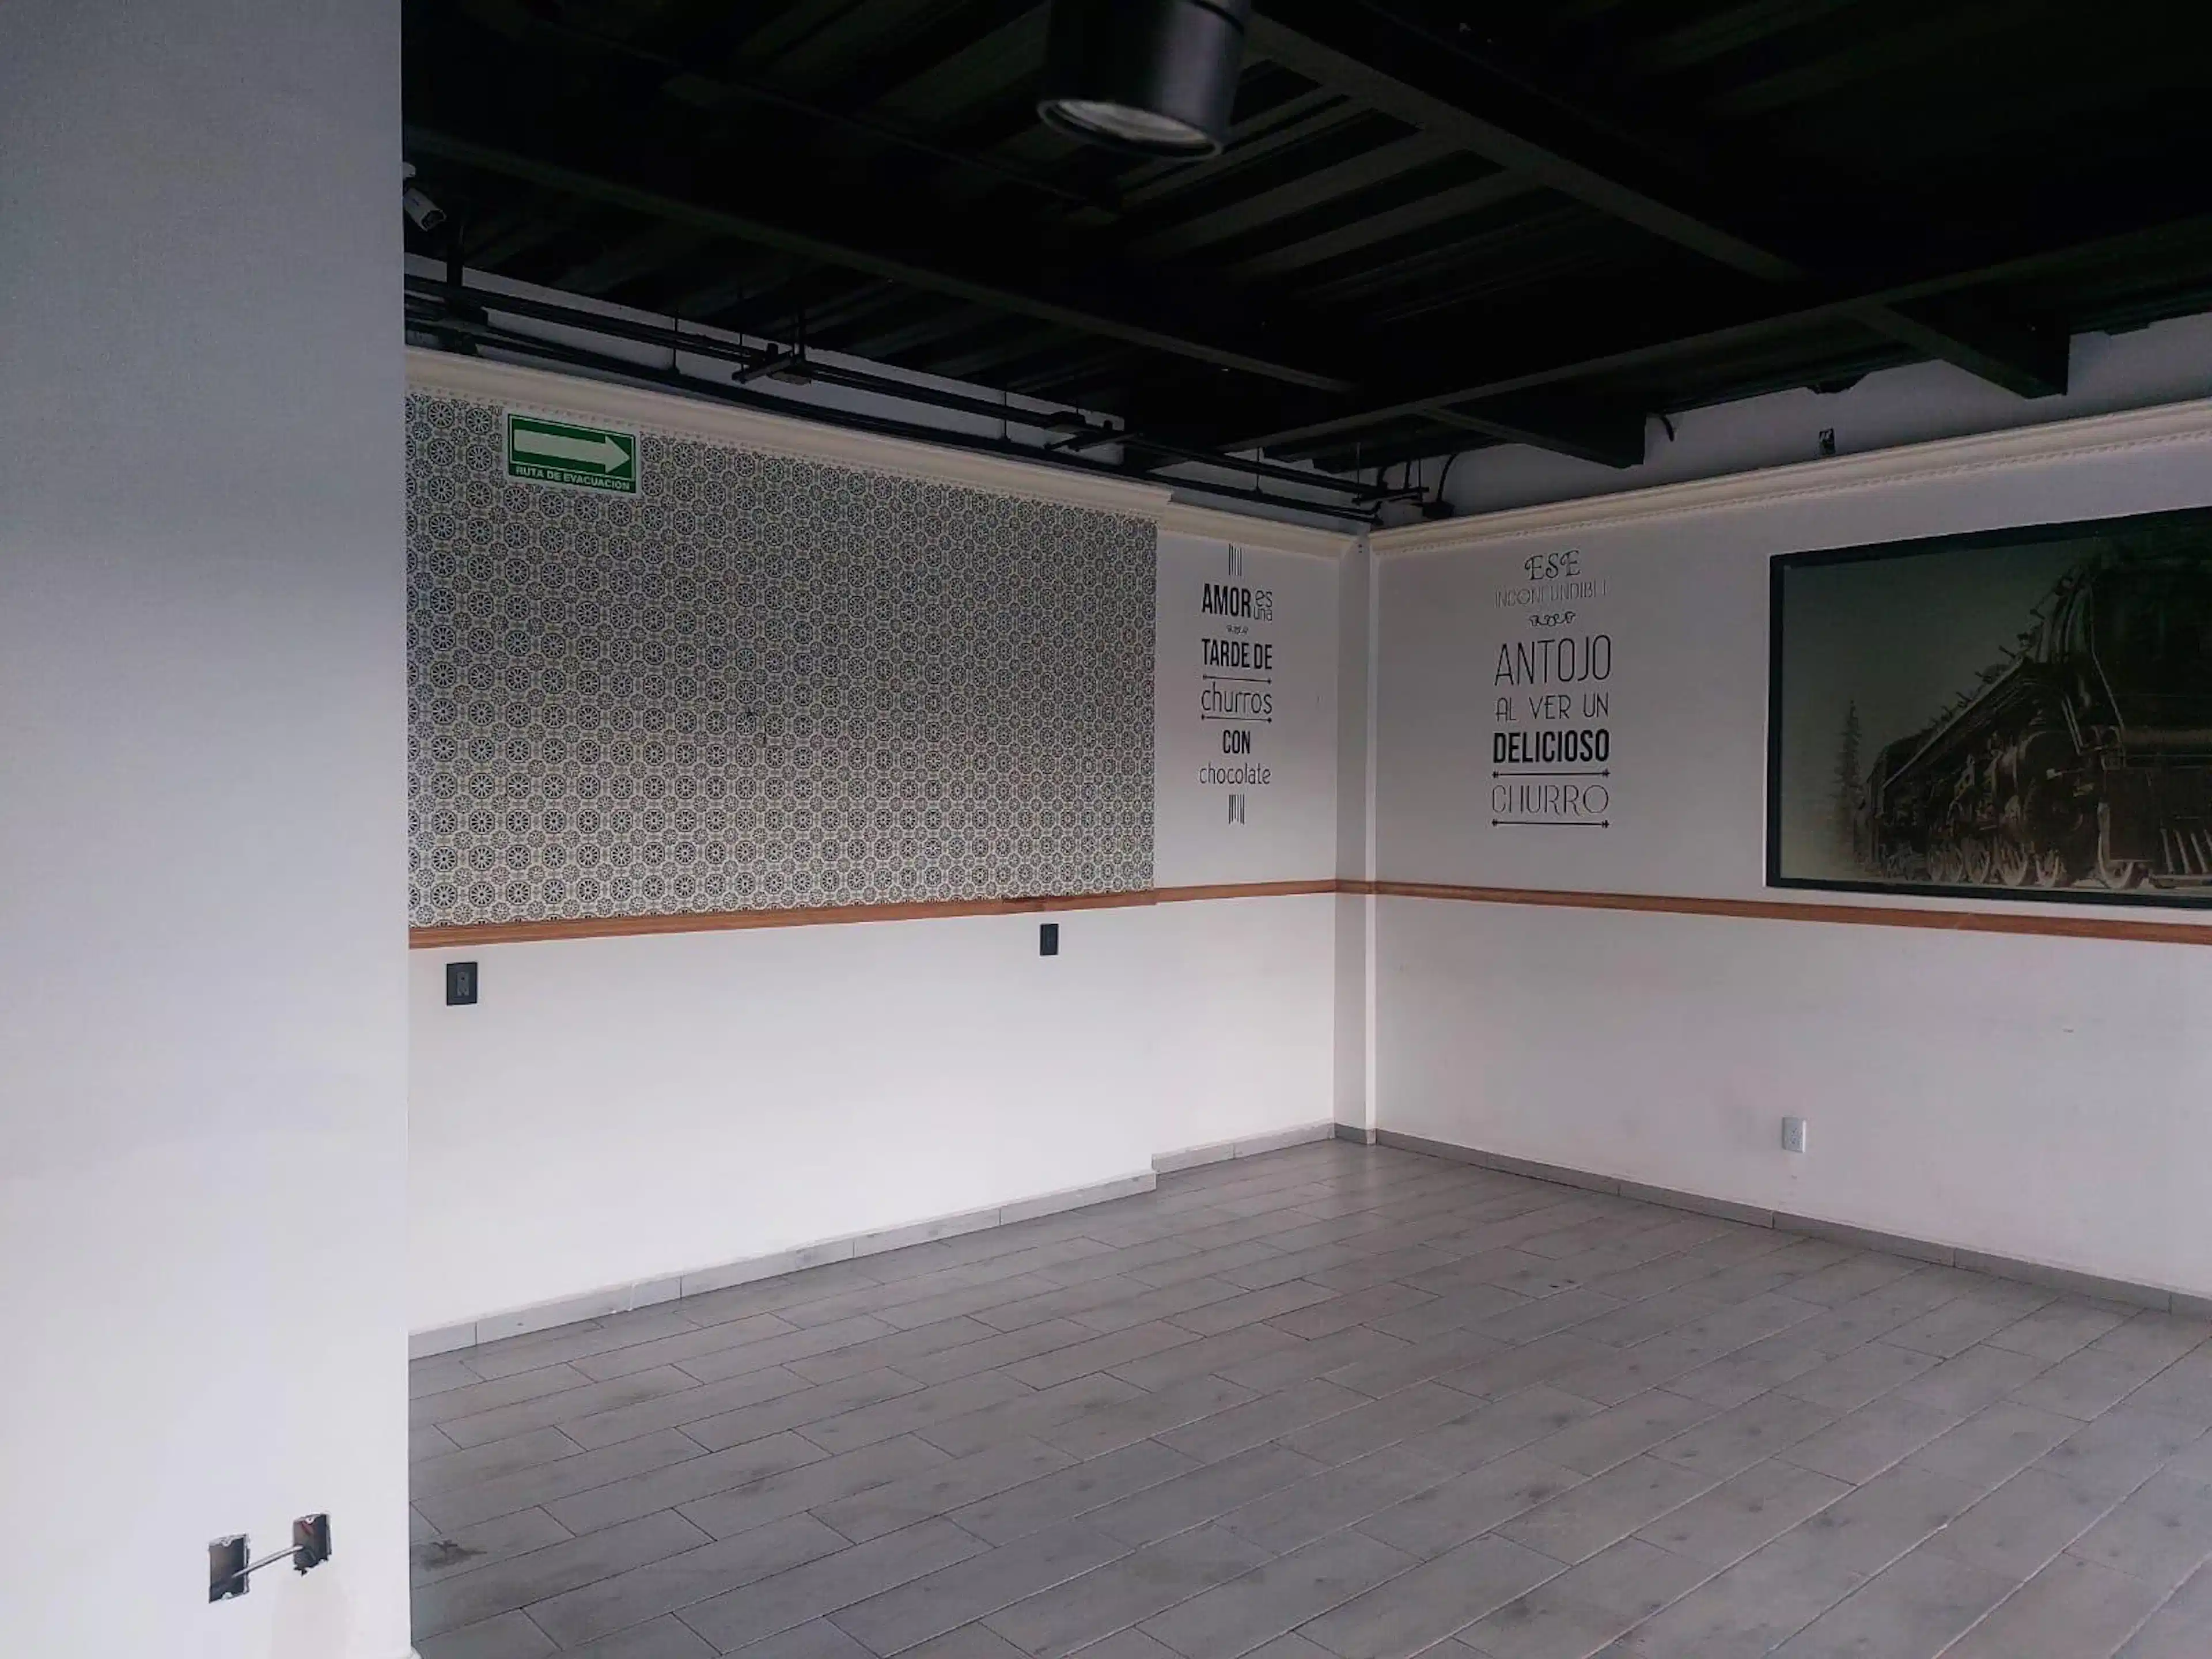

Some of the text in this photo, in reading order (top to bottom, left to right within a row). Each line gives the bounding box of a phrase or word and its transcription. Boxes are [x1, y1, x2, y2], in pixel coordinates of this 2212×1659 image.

[516, 465, 544, 479] RUTA
[547, 470, 563, 482] DE
[1524, 550, 1581, 581] ESE
[1202, 583, 1272, 618] AMOR es
[1253, 606, 1272, 621] una
[1202, 638, 1272, 669] TARDE DE
[1494, 634, 1611, 686] ANTOJO
[1201, 681, 1272, 715] churros
[1495, 692, 1608, 722] AL VER UN
[1222, 729, 1251, 754] CON
[1493, 729, 1609, 763] DELICIOSO
[1199, 760, 1271, 785] chocolate
[1492, 785, 1609, 816] CHURRO
